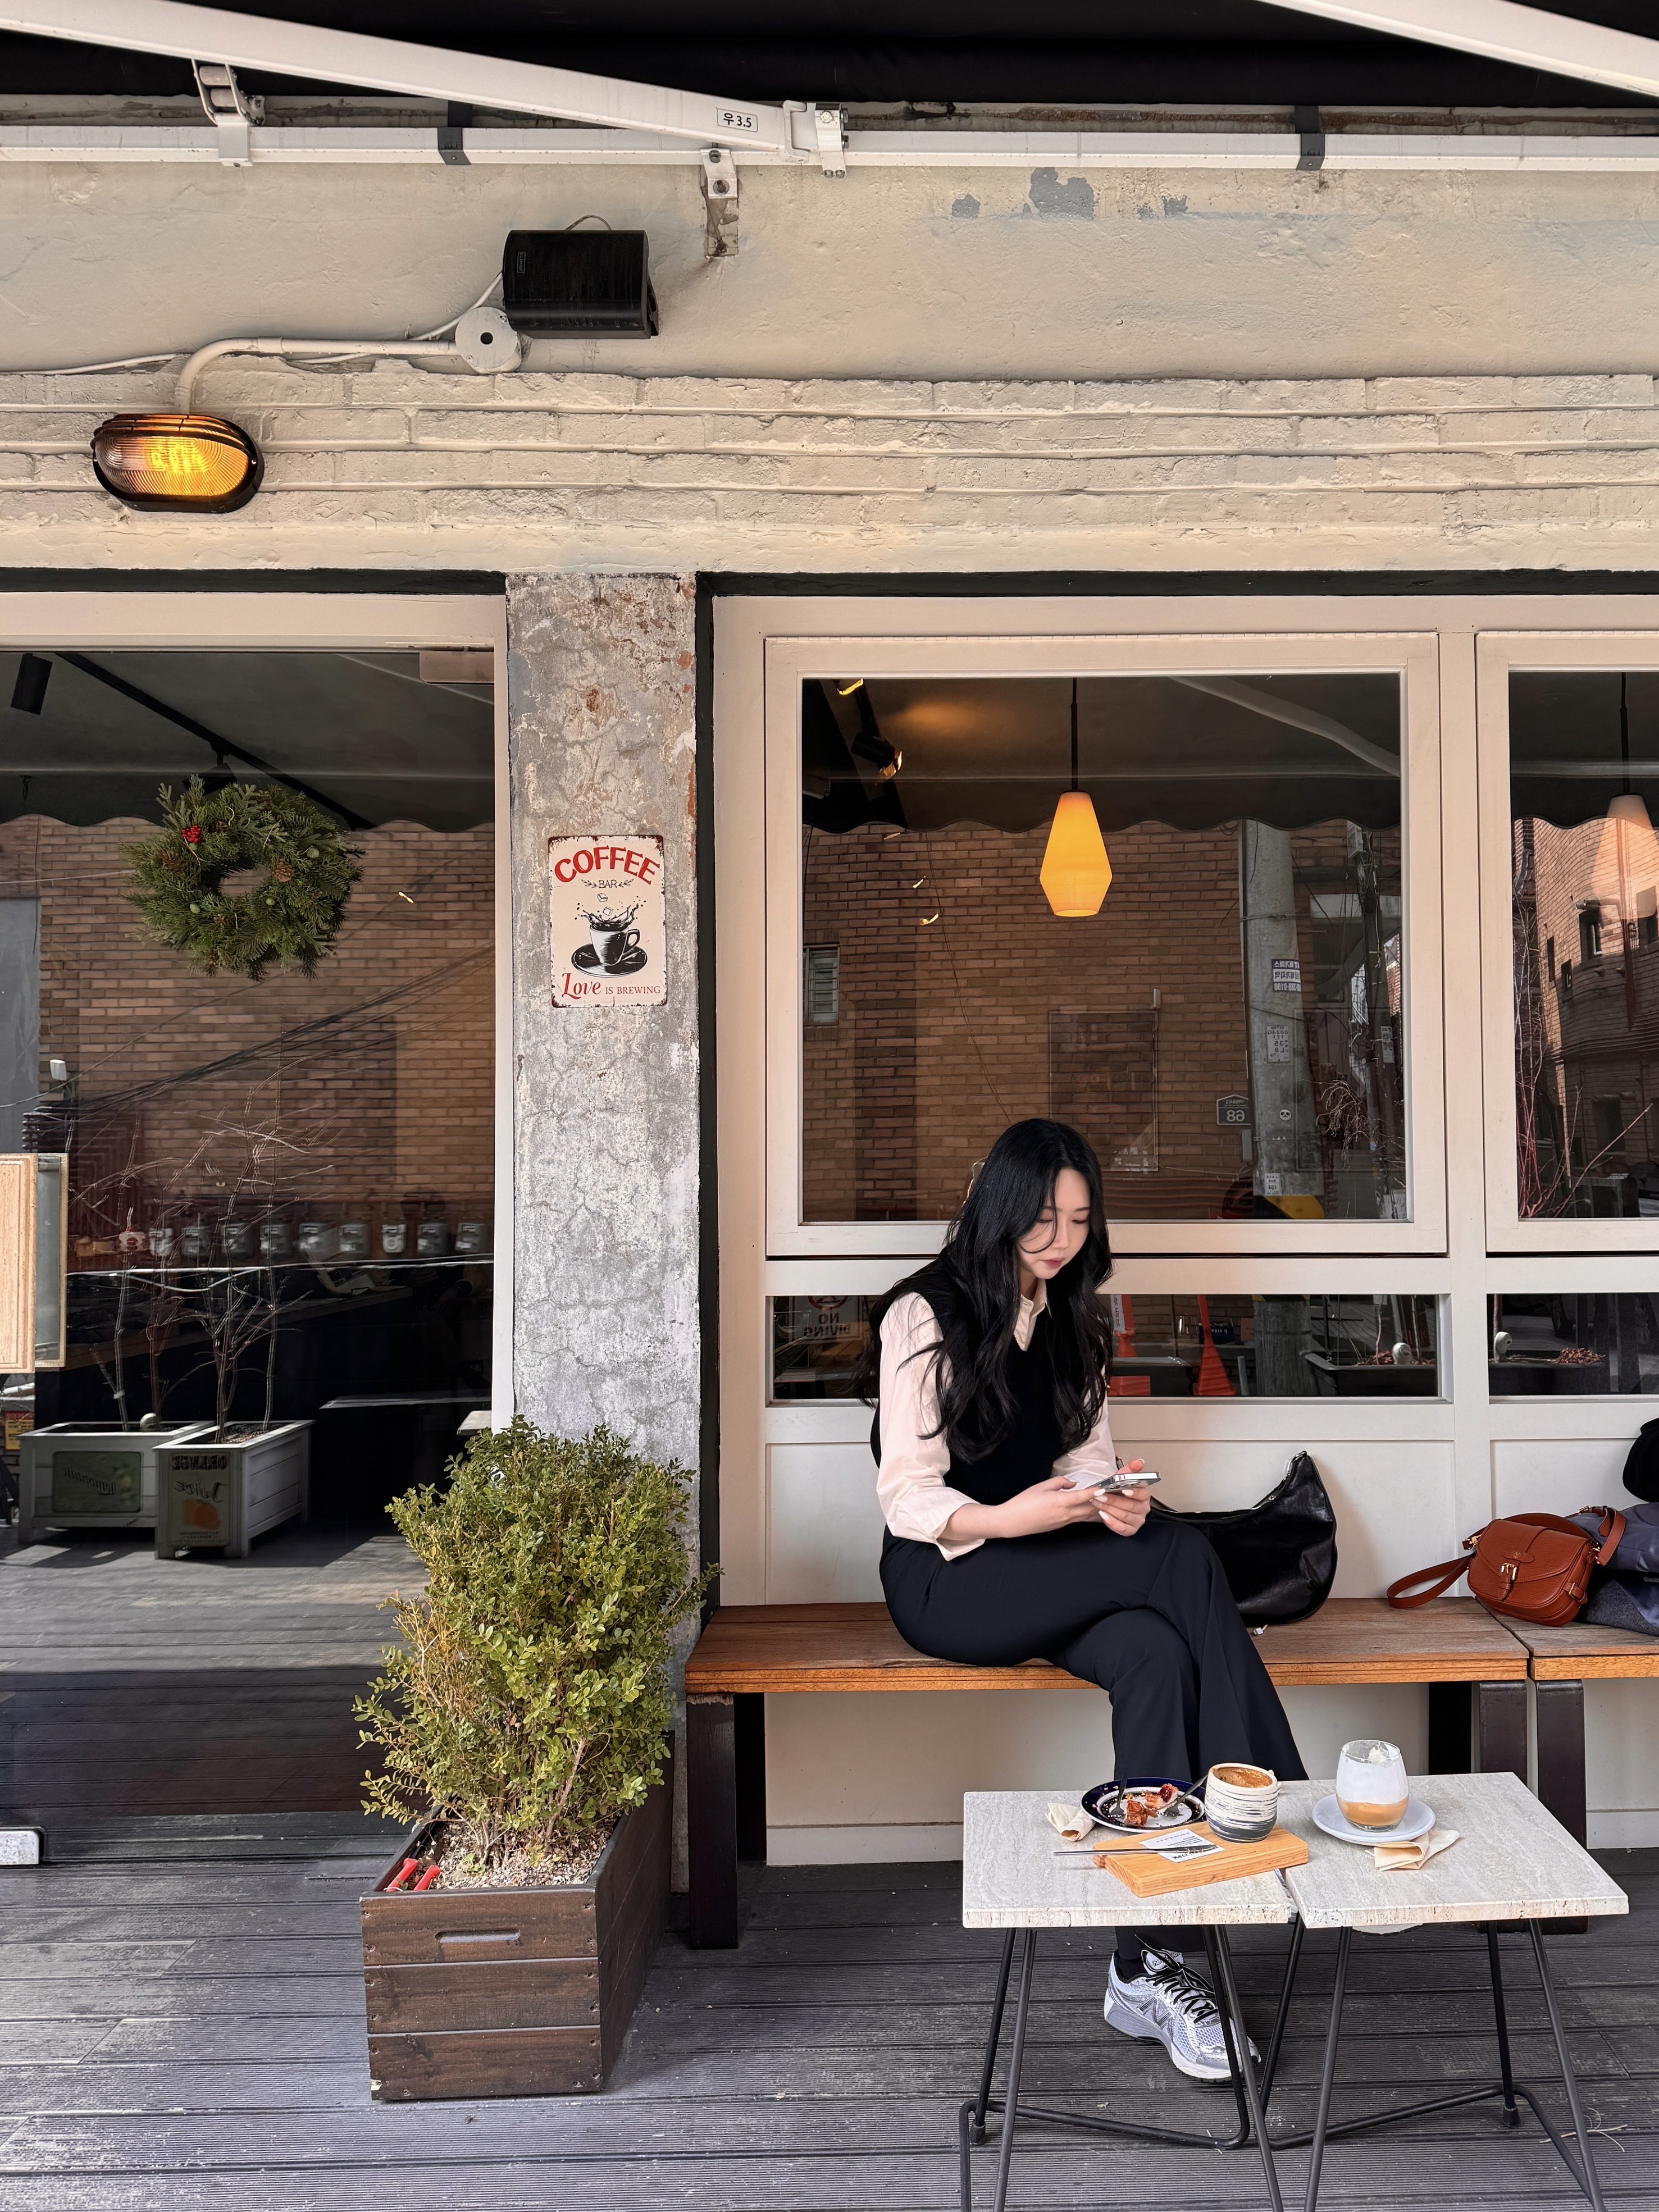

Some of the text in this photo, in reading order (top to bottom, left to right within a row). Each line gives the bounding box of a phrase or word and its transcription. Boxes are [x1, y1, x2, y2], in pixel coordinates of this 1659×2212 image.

[554, 845, 660, 885] COFFEE
[598, 879, 618, 888] BAR
[562, 973, 601, 1000] Love
[617, 986, 661, 995] BREWING
